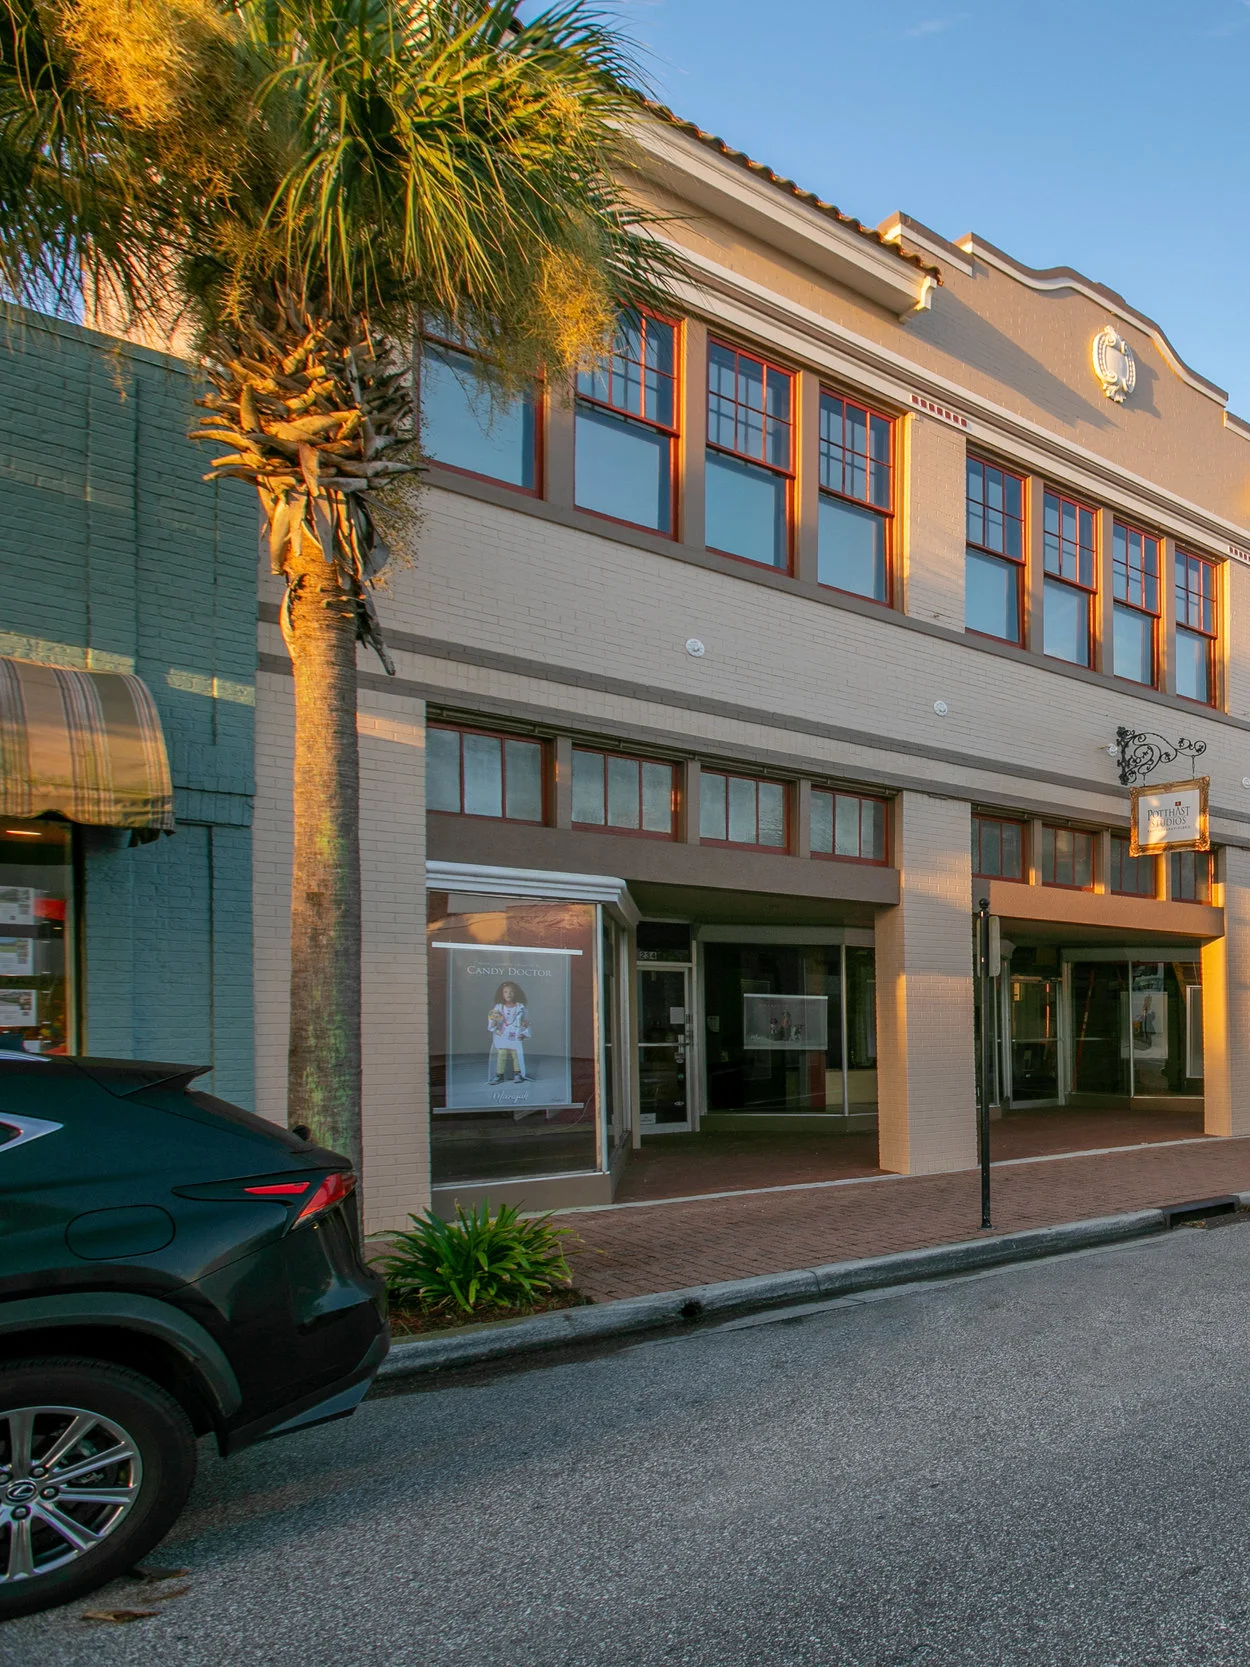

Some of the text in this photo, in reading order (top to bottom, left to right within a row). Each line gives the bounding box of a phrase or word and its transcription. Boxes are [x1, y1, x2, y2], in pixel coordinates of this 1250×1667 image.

[1147, 806, 1190, 820] POTTHAST
[1151, 816, 1187, 827] STUDIOS
[466, 965, 552, 977] CANDY DOCTOR
